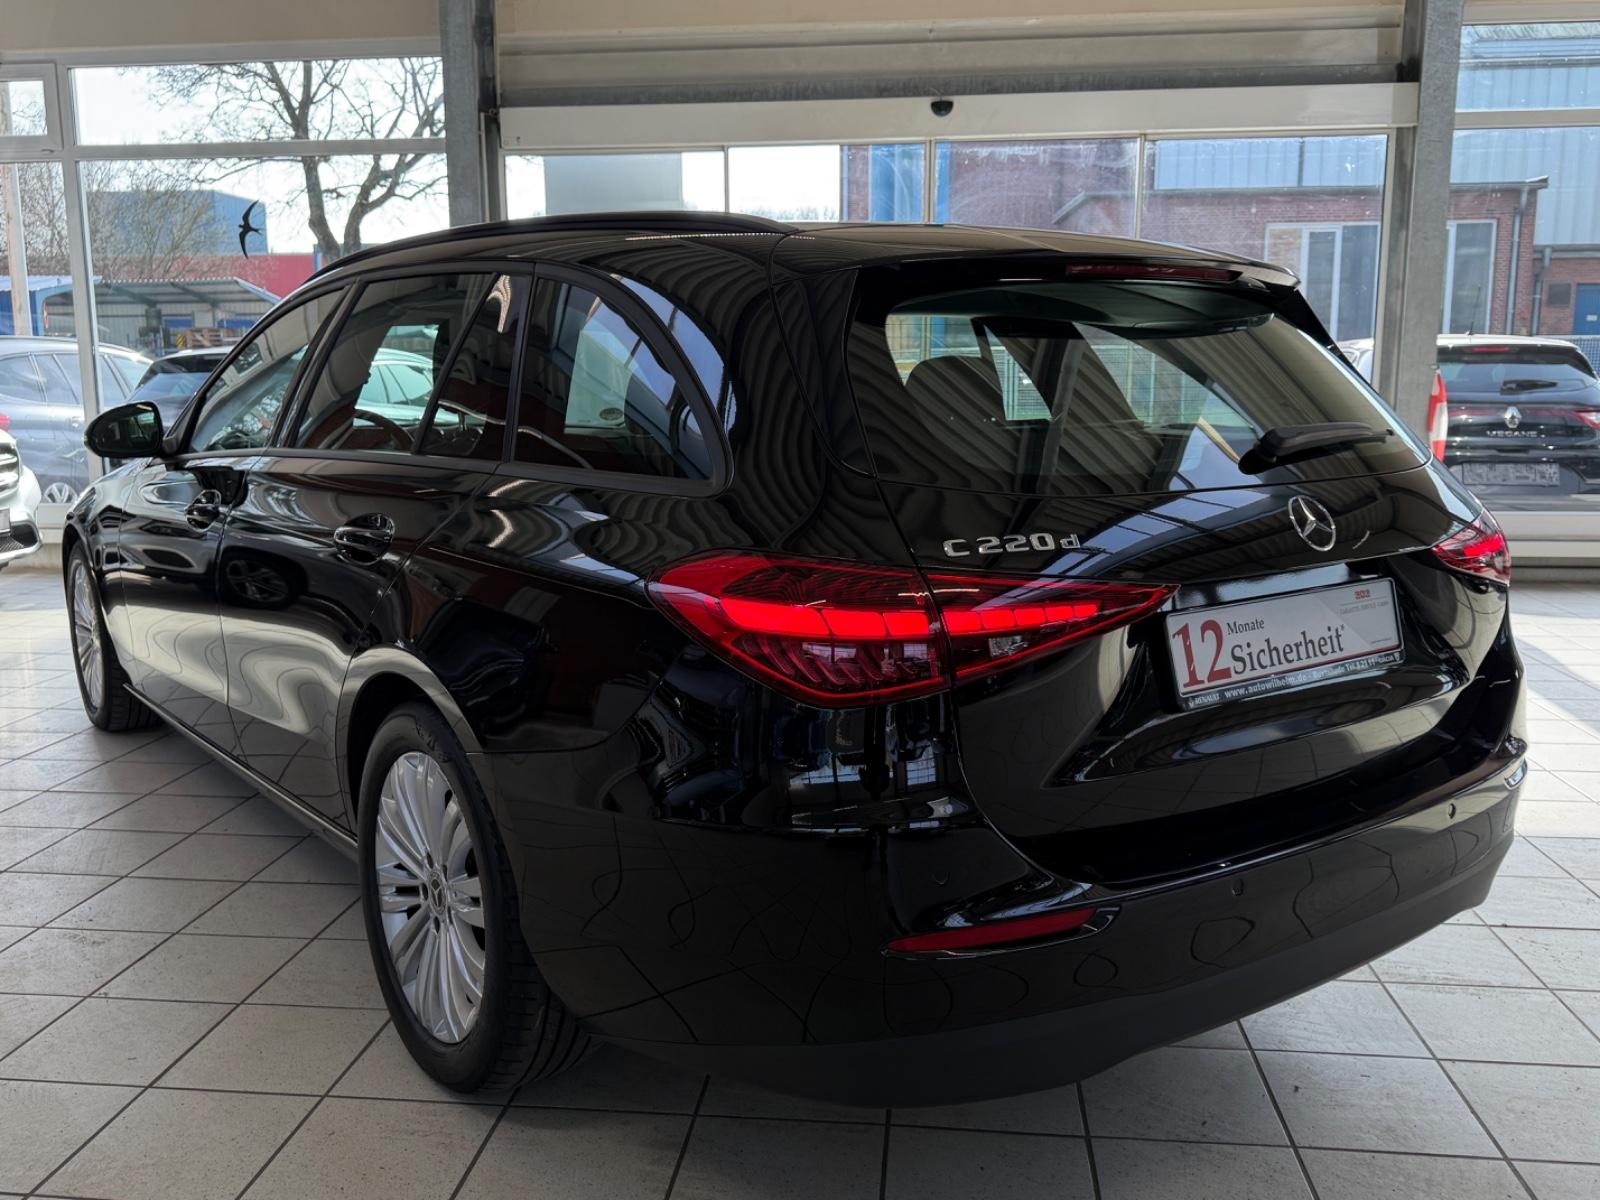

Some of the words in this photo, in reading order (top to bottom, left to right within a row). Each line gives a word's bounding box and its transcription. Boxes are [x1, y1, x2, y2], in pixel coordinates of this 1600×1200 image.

[942, 539, 971, 557] C
[976, 532, 1056, 554] 220
[1059, 533, 1081, 549] d
[1226, 617, 1265, 636] Monate
[1171, 618, 1233, 689] 12
[1224, 672, 1307, 700] www.autowilhelm.de
